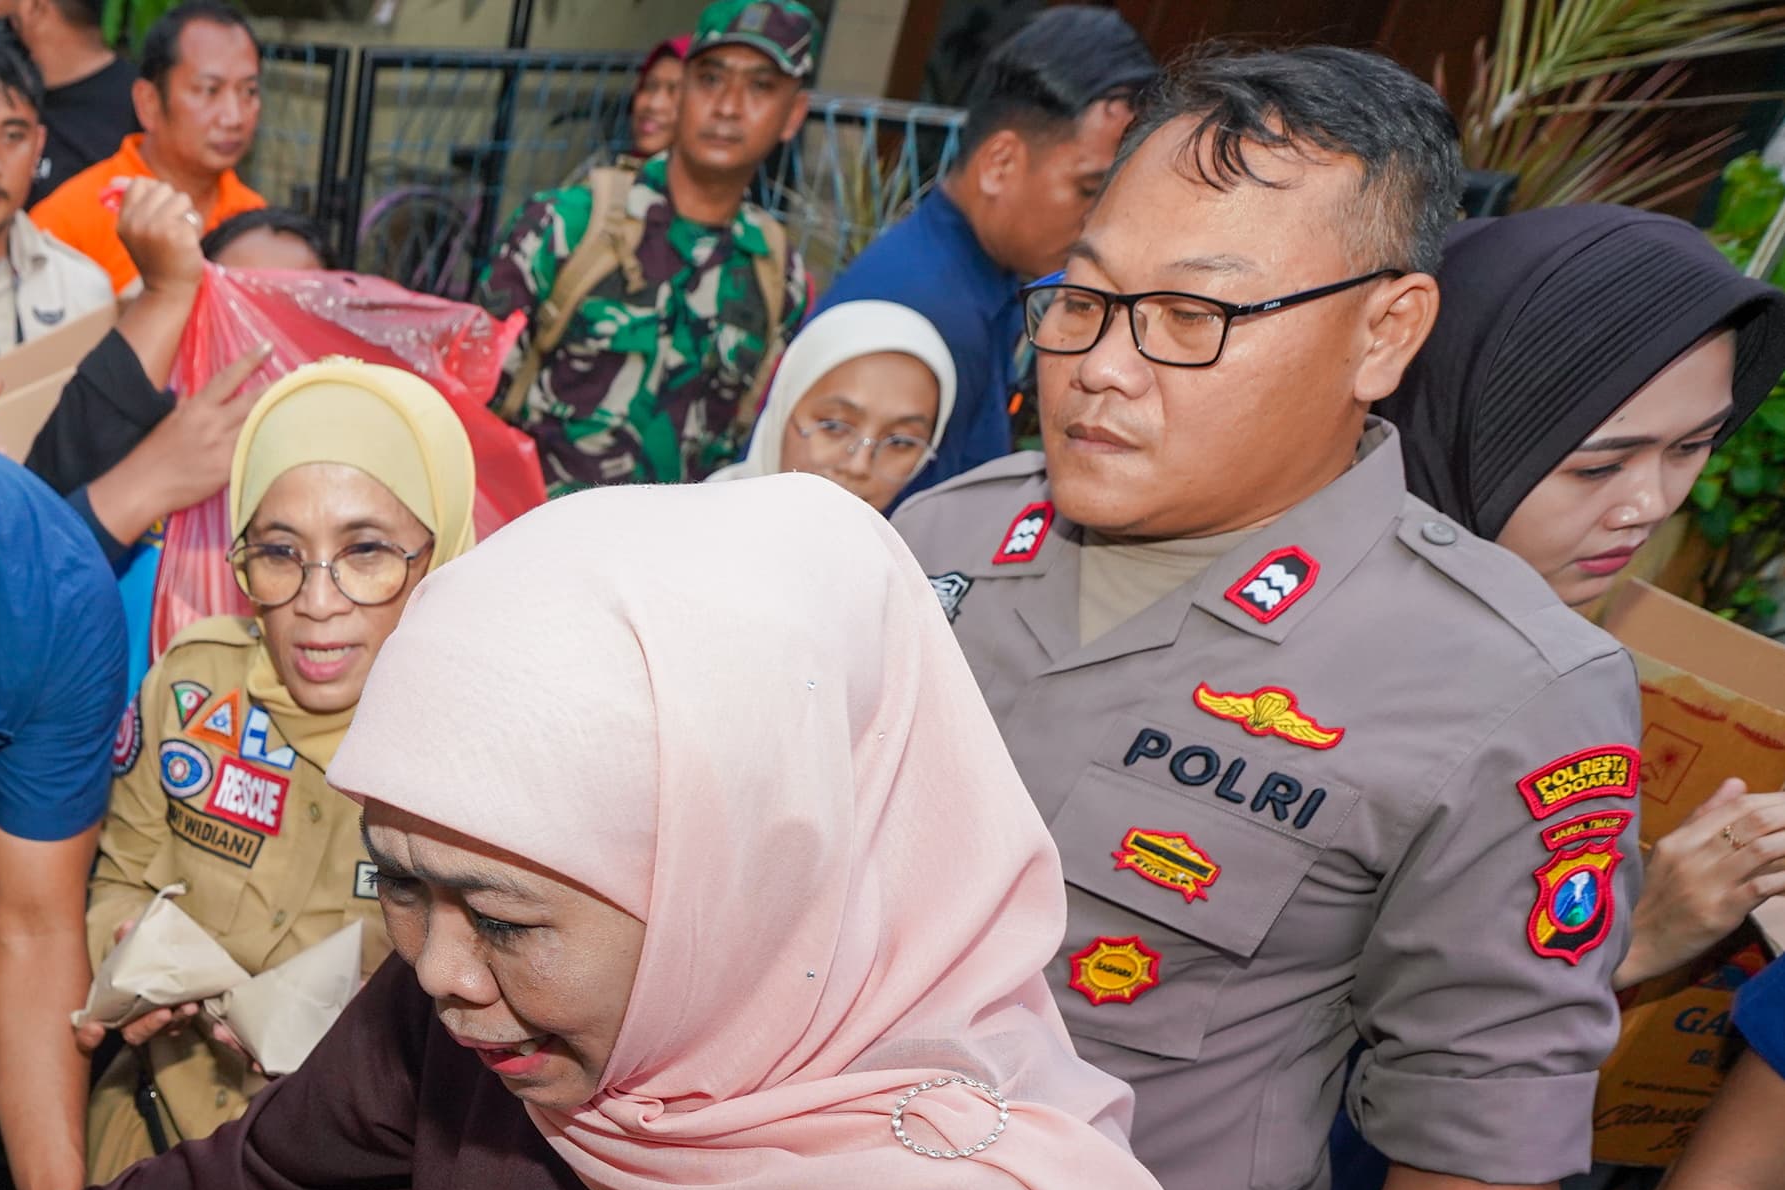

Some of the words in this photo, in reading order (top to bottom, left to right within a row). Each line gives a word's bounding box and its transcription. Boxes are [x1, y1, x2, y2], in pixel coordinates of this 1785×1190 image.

[214, 763, 282, 828] RESCUE
[1123, 728, 1326, 829] POLRI
[1535, 754, 1628, 795] POLRESTA
[1542, 771, 1627, 805] SIDOARJO
[184, 812, 255, 858] WIDIANI
[1551, 822, 1586, 842] JAWA
